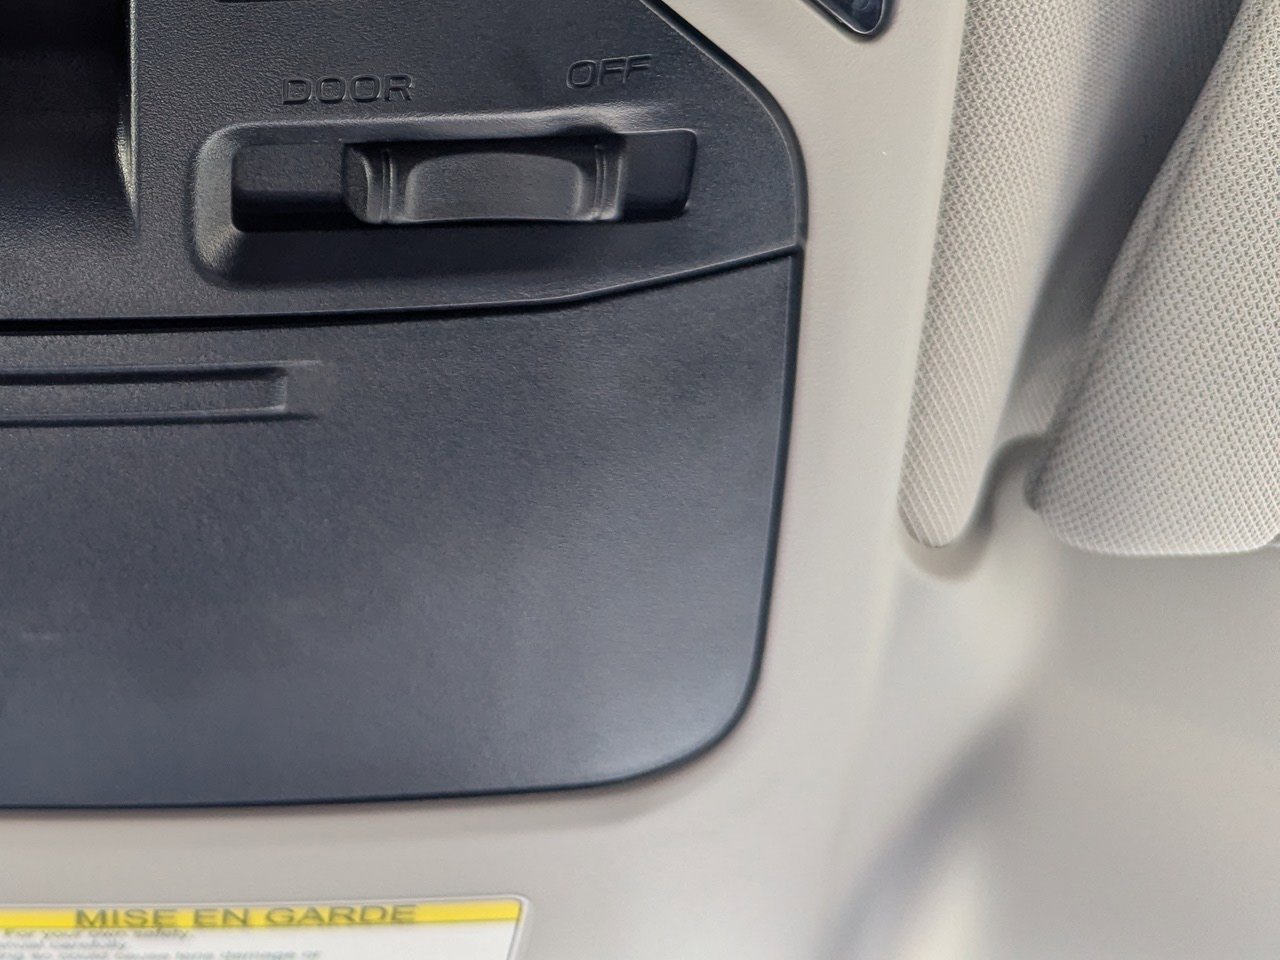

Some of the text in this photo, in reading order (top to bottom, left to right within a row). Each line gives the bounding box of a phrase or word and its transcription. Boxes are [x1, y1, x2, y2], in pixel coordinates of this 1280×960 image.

[281, 72, 416, 106] DOOR
[565, 54, 654, 90] OFF
[74, 904, 418, 929] MISE EN GARDE
